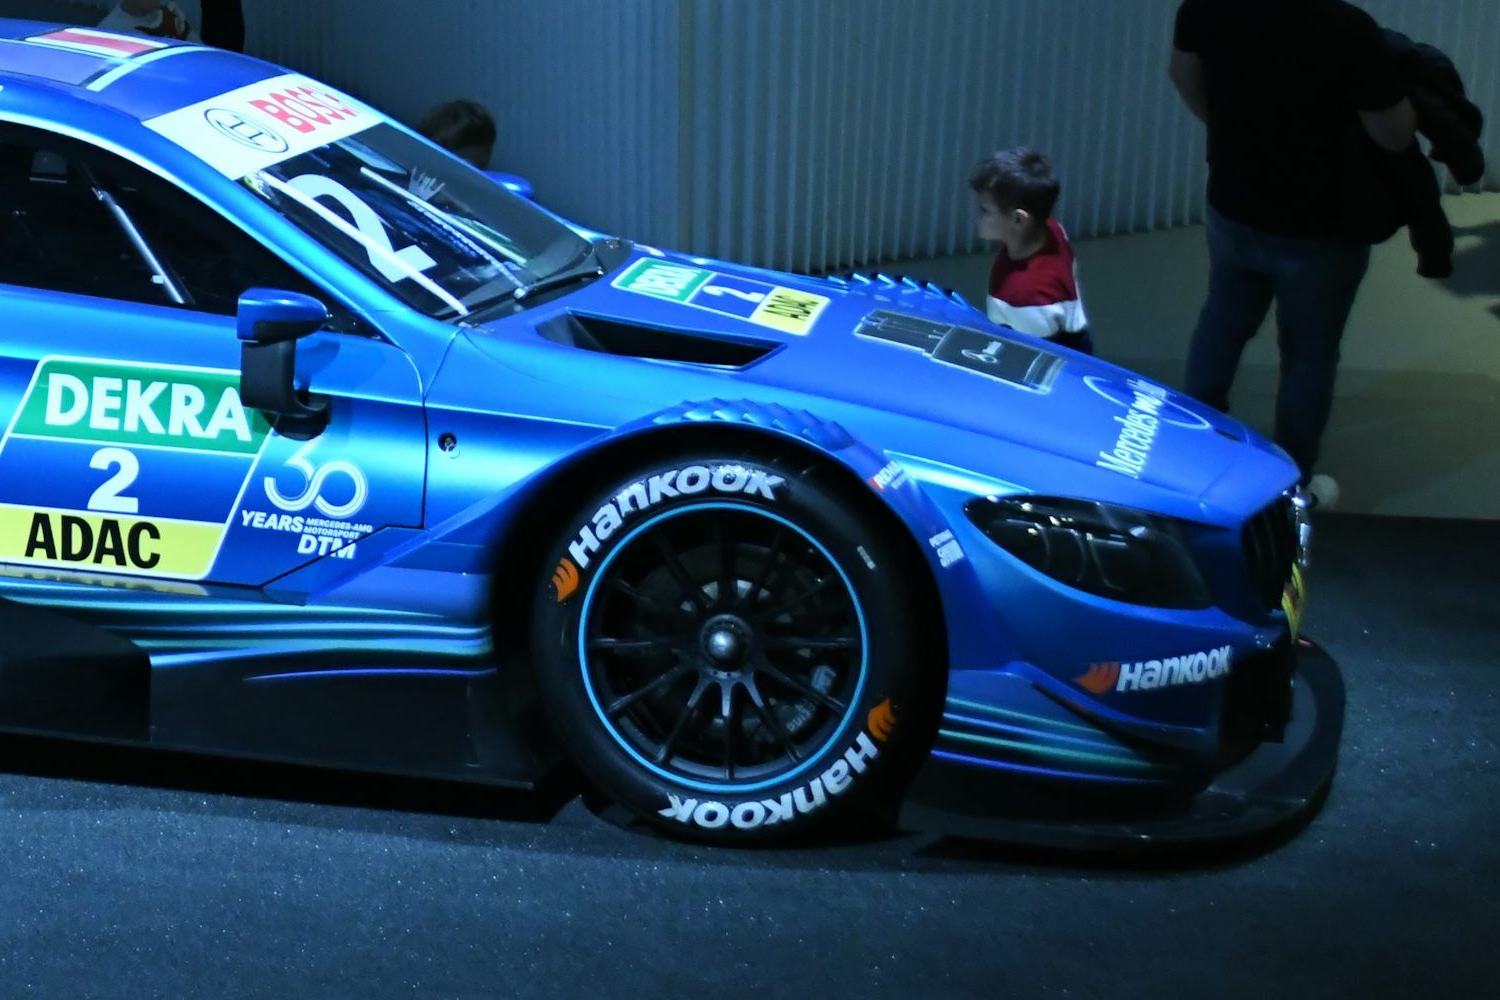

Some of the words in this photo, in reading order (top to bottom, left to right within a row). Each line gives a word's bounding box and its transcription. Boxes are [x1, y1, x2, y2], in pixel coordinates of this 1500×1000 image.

[702, 284, 768, 303] 2
[45, 373, 253, 442] DEKRA
[1096, 407, 1160, 480] Mercedes
[87, 447, 140, 514] 2
[263, 435, 369, 520] 30
[24, 511, 162, 570] ADAC
[241, 510, 304, 533] YEARS
[303, 527, 360, 540] MOTORSPORT
[305, 517, 373, 534] MERCEDES-AMG
[297, 533, 357, 560] DTM
[1115, 645, 1231, 692] Hankook
